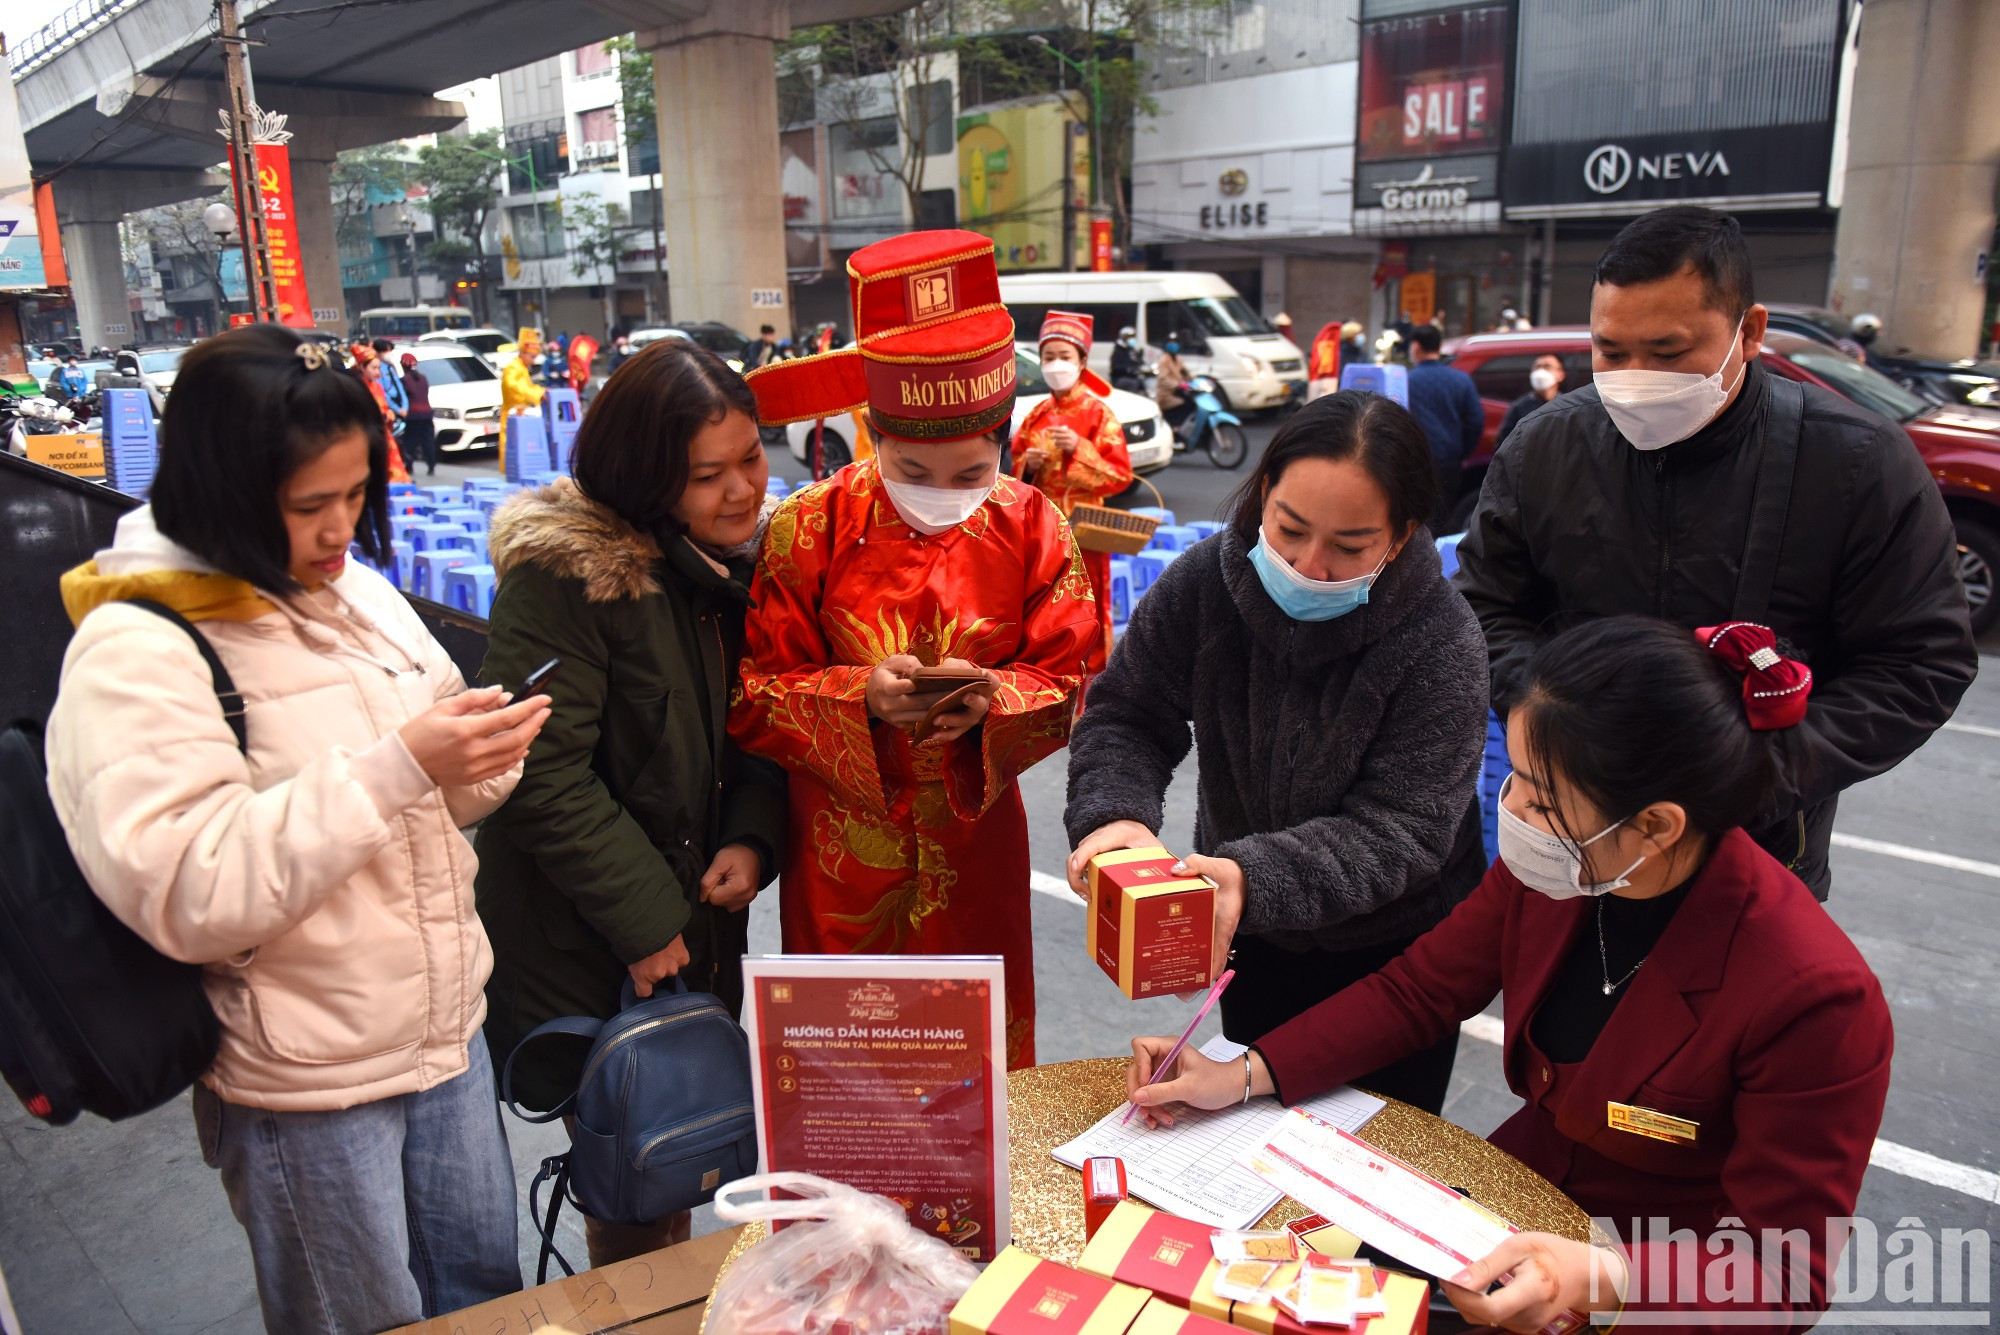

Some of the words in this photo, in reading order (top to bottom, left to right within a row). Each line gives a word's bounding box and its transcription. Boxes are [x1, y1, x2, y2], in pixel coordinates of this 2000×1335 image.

[1404, 86, 1486, 138] SALE
[1638, 151, 1731, 181] NEVA
[1381, 187, 1469, 210] Germe
[1200, 202, 1268, 229] ELISE
[900, 373, 935, 407] BẢO
[937, 372, 966, 406] TÍN
[969, 367, 1001, 403] MINH
[784, 1025, 835, 1038] HƯỚNG
[837, 1023, 869, 1039] DẪN
[871, 1025, 921, 1039] KHÁCH
[923, 1026, 965, 1040] HÀNG
[783, 1040, 822, 1048] CHECKIN
[901, 1040, 923, 1051] QUÀ
[924, 1042, 945, 1050] MAY
